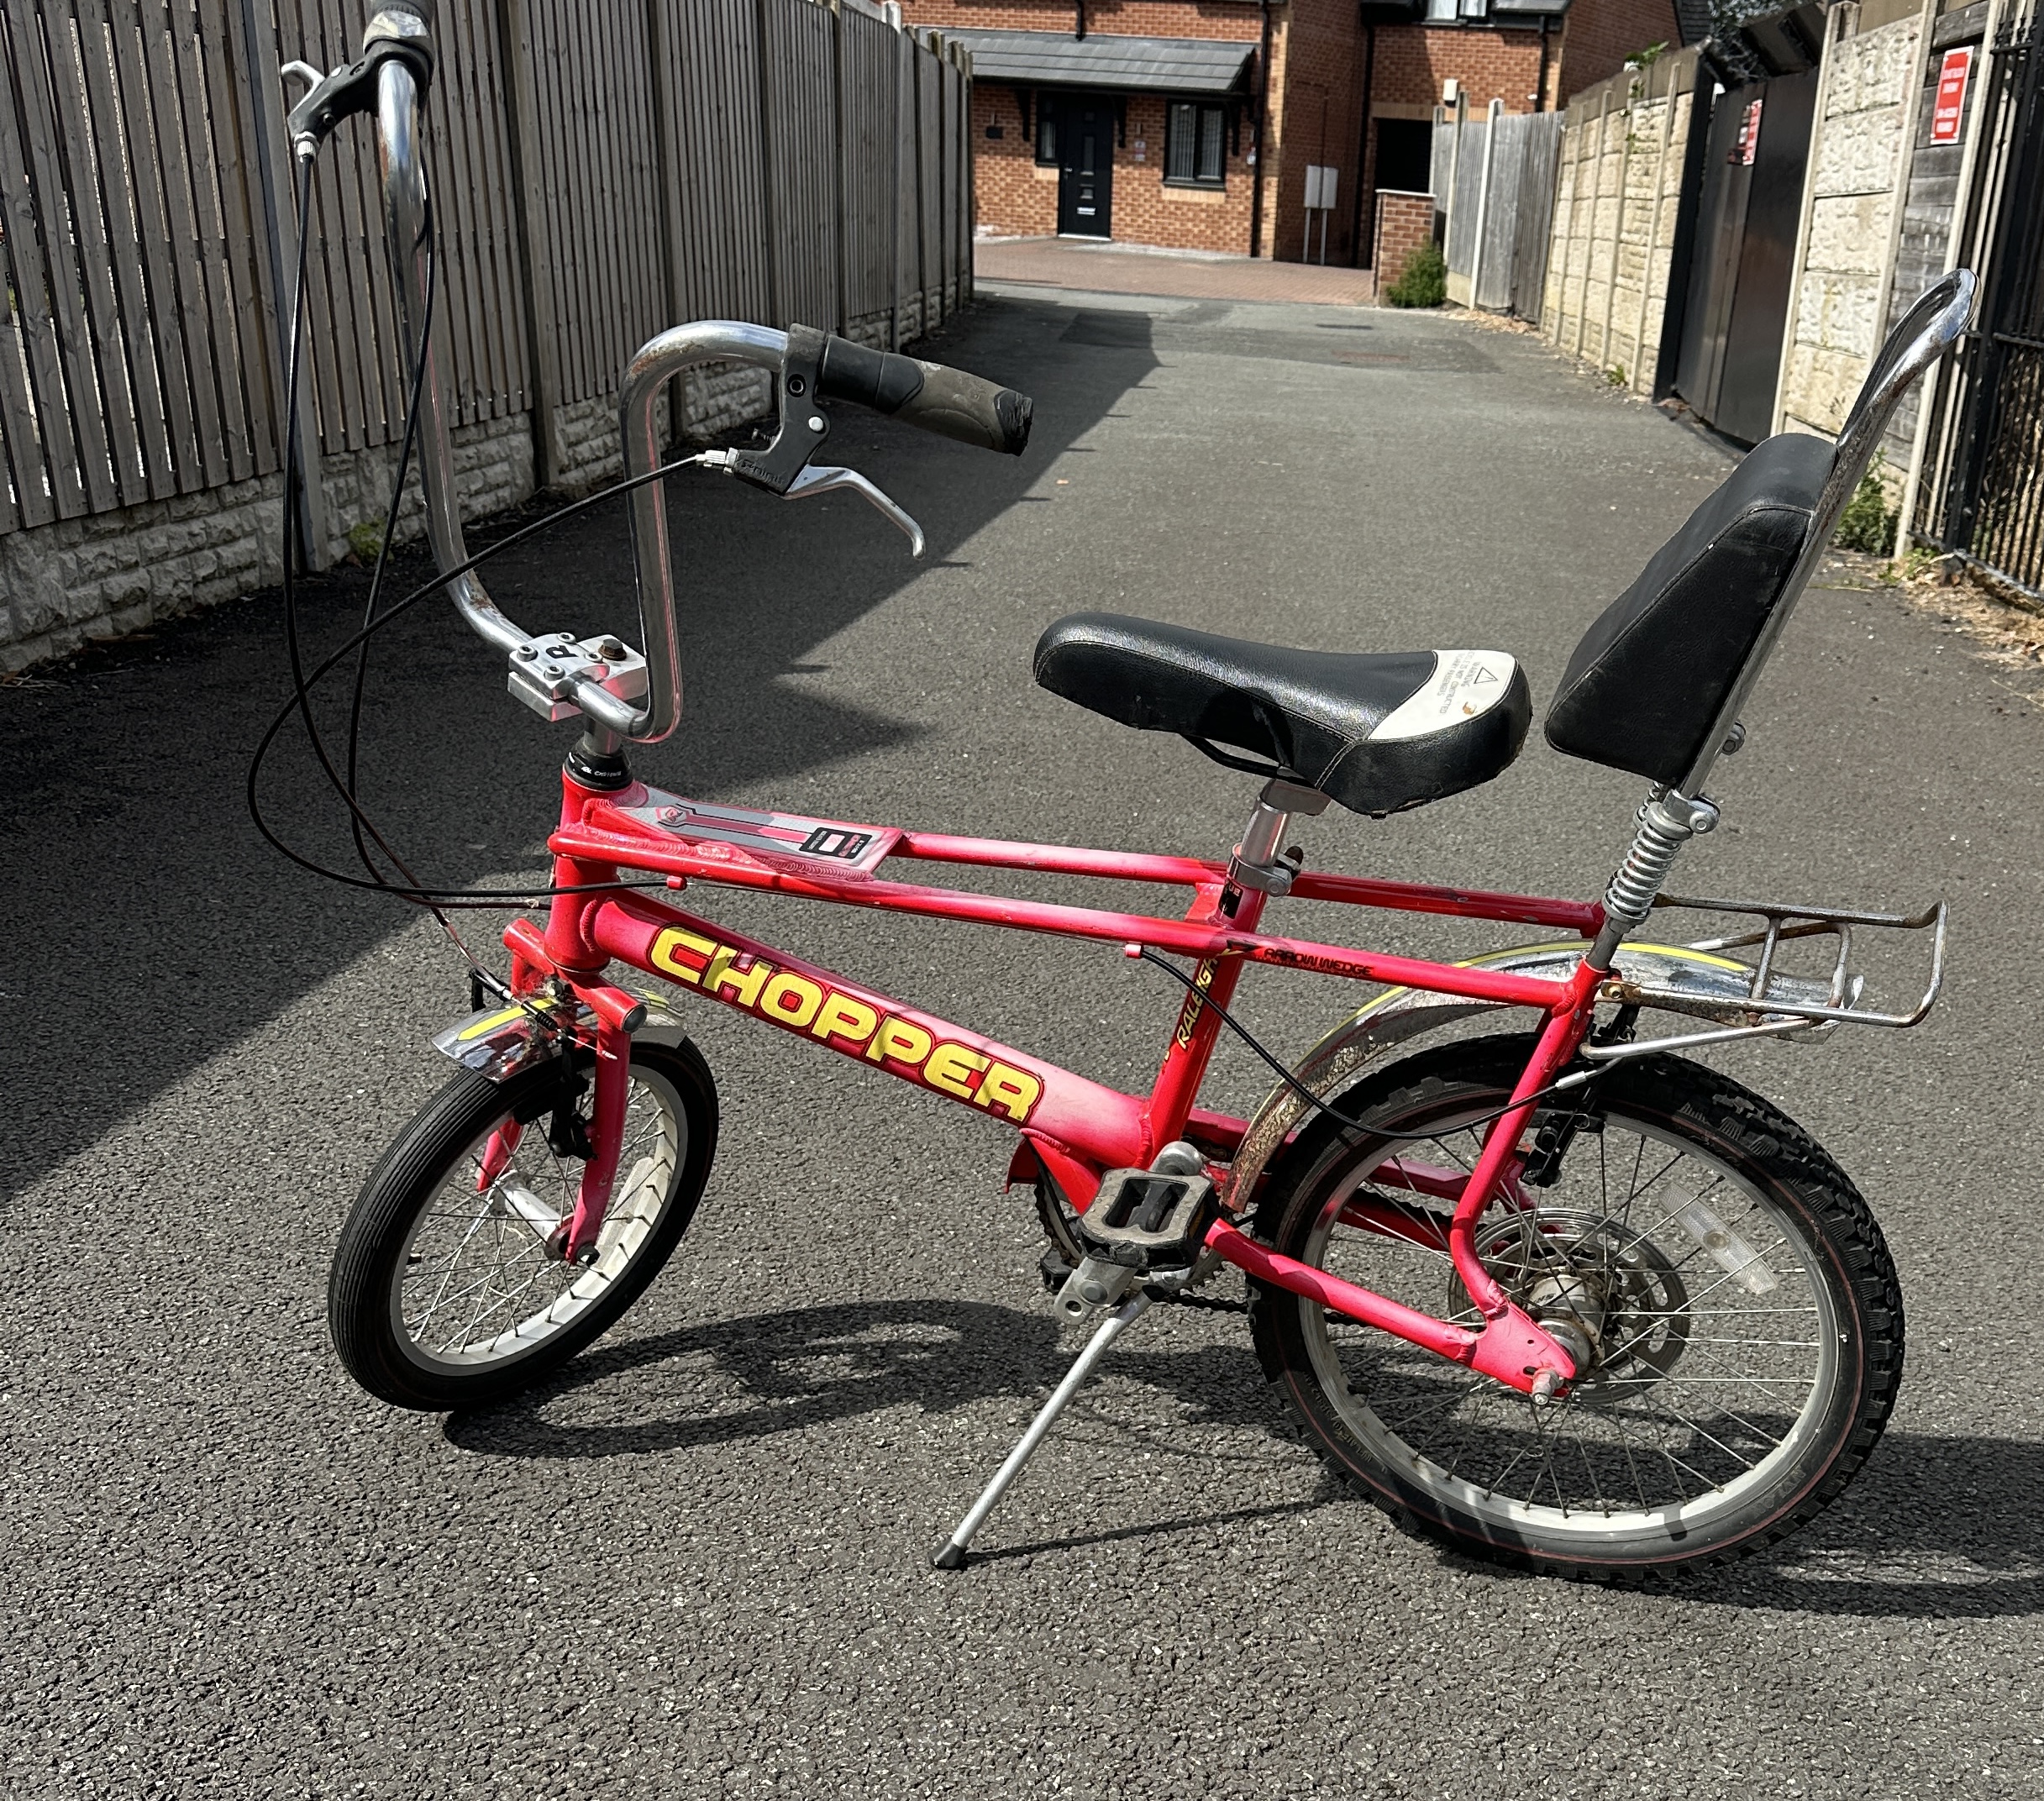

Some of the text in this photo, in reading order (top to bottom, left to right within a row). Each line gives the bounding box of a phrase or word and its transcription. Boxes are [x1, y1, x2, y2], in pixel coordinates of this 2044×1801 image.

[1264, 948, 1375, 976] ARROW WEDGE
[650, 927, 1043, 1121] CHOPPER
